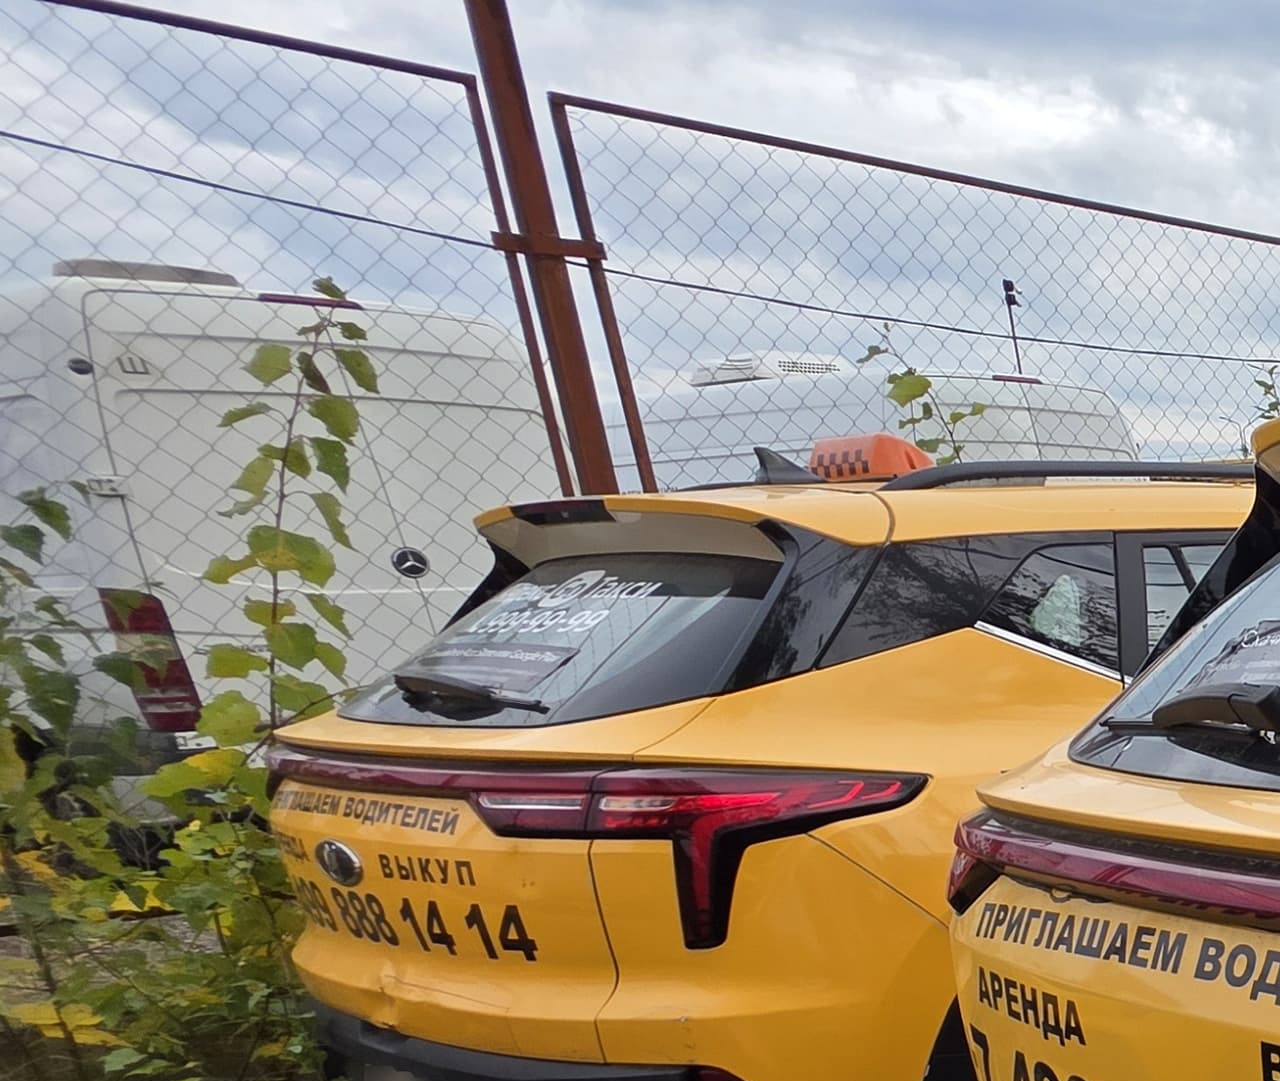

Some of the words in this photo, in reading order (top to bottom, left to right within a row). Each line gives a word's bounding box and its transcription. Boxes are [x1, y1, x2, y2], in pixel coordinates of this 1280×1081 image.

[583, 576, 663, 600] Такси
[477, 608, 610, 634] 999-99-99
[343, 797, 460, 835] ВОДИТЕЛЕЙ
[378, 854, 477, 887] ВЫКУП
[330, 886, 400, 947] 888
[398, 897, 458, 956] 14
[464, 902, 539, 962] 14
[976, 902, 1189, 975] ПРИГЛАШАЕМ
[978, 965, 1087, 1048] АРЕНДА
